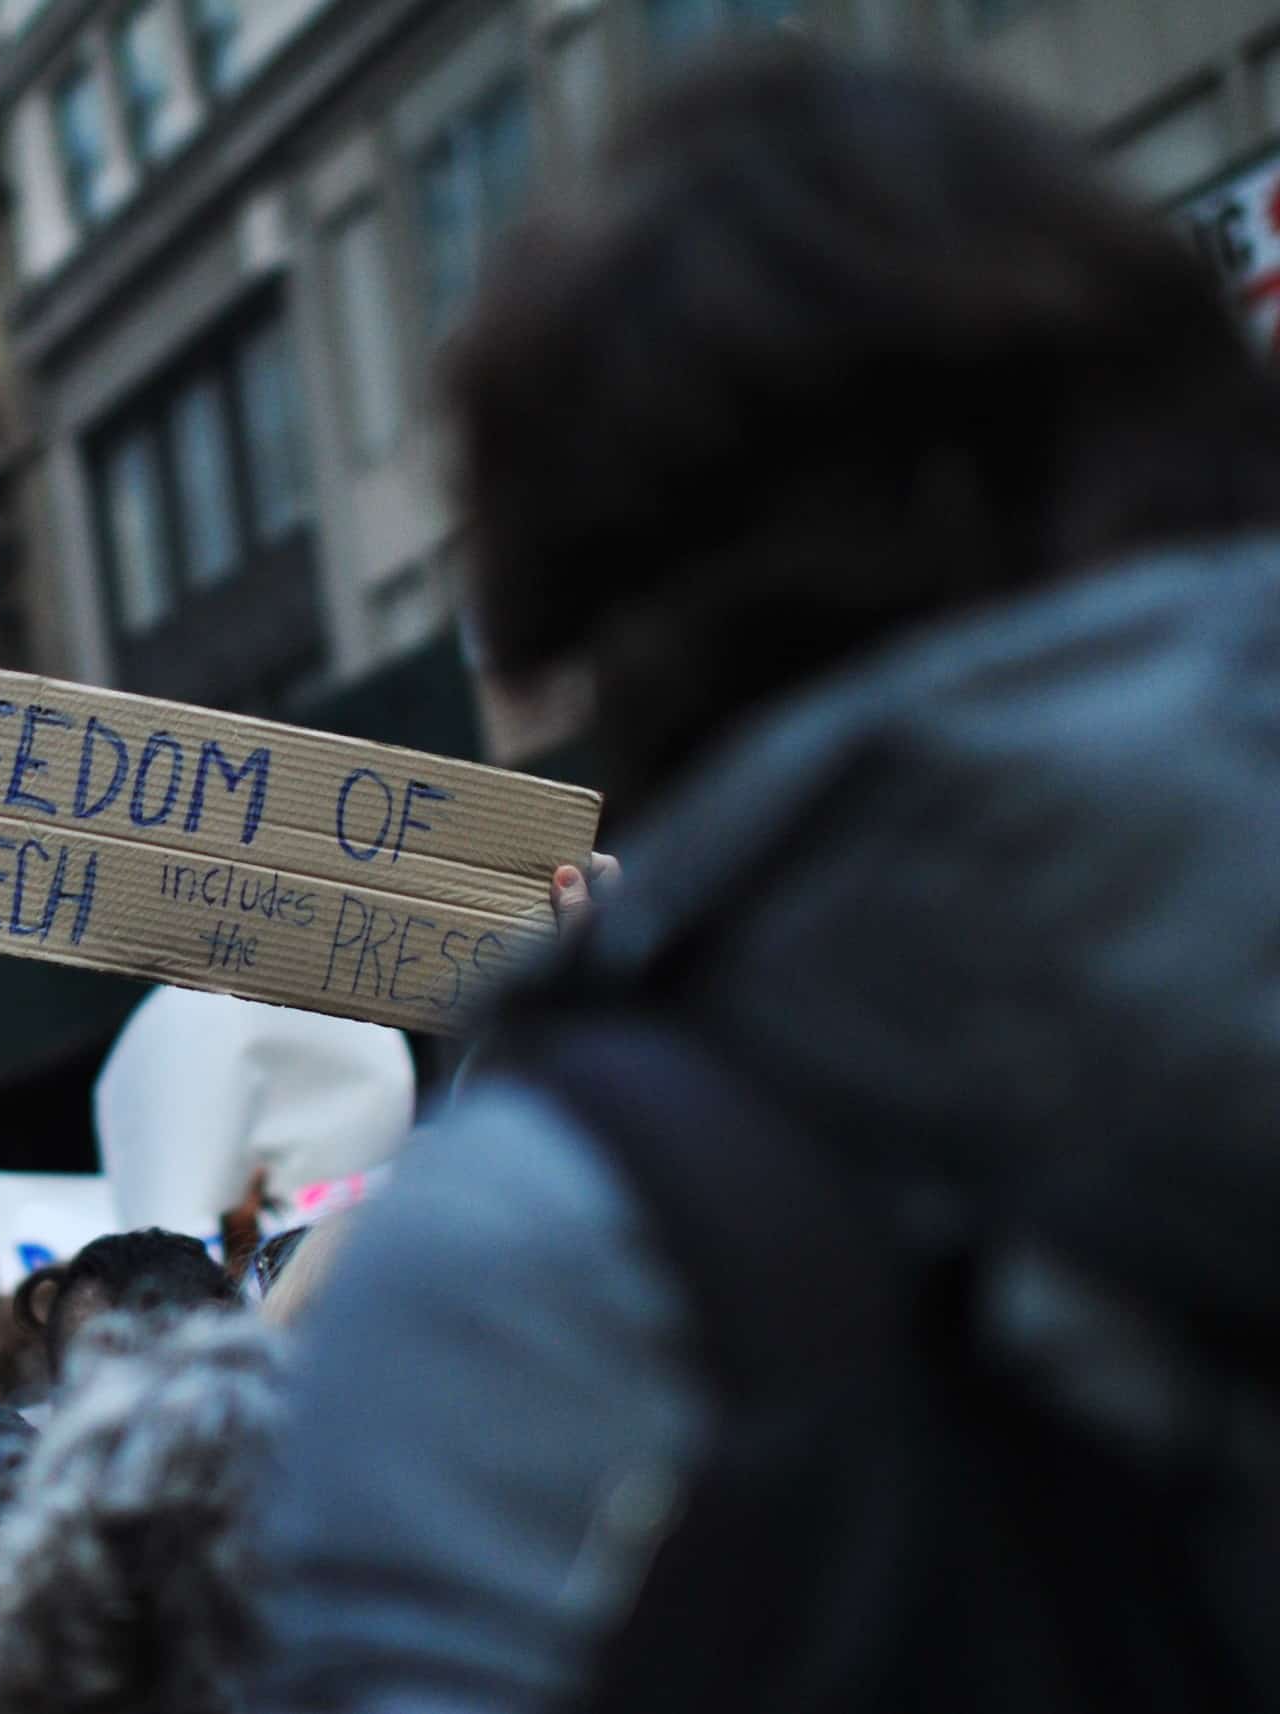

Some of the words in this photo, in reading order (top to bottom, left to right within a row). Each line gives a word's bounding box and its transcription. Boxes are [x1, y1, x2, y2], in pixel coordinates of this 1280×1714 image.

[336, 768, 455, 863] OF
[161, 854, 317, 929] includes
[201, 919, 258, 971] the
